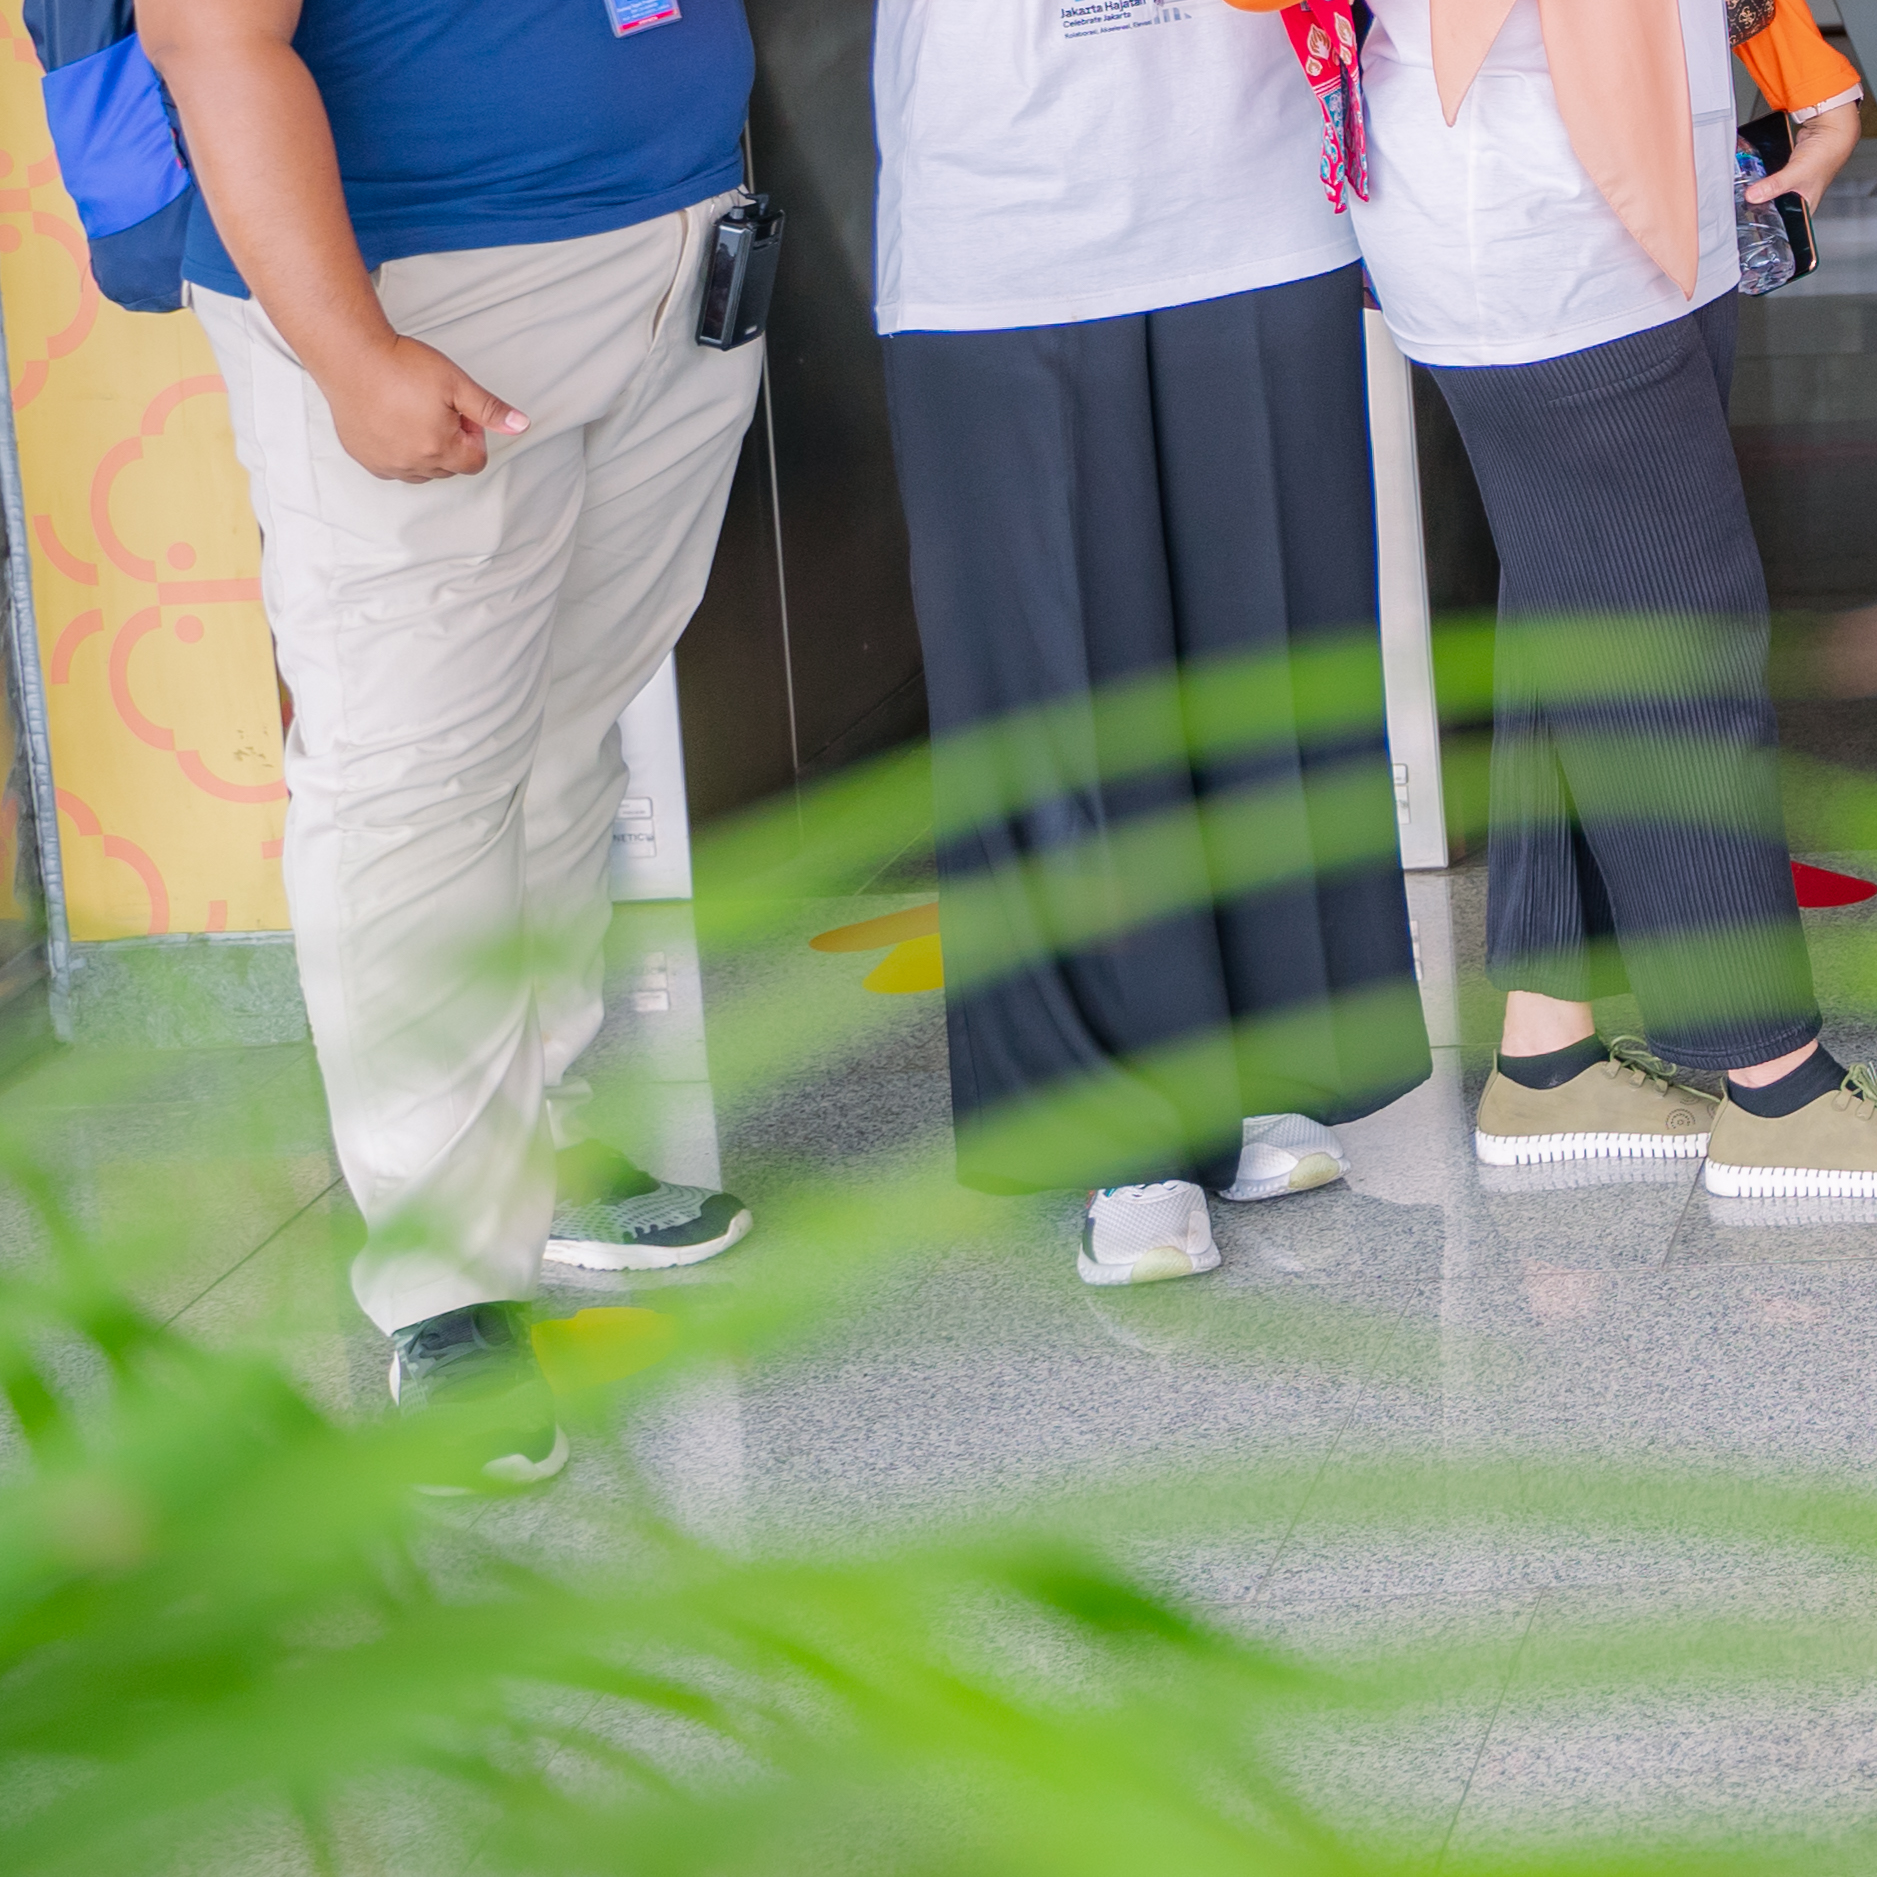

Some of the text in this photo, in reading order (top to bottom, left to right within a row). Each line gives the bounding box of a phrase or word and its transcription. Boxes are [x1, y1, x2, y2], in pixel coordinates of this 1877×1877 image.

[1061, 3, 1103, 19] Jakarta
[1063, 11, 1132, 29] Celebrate Jakarta
